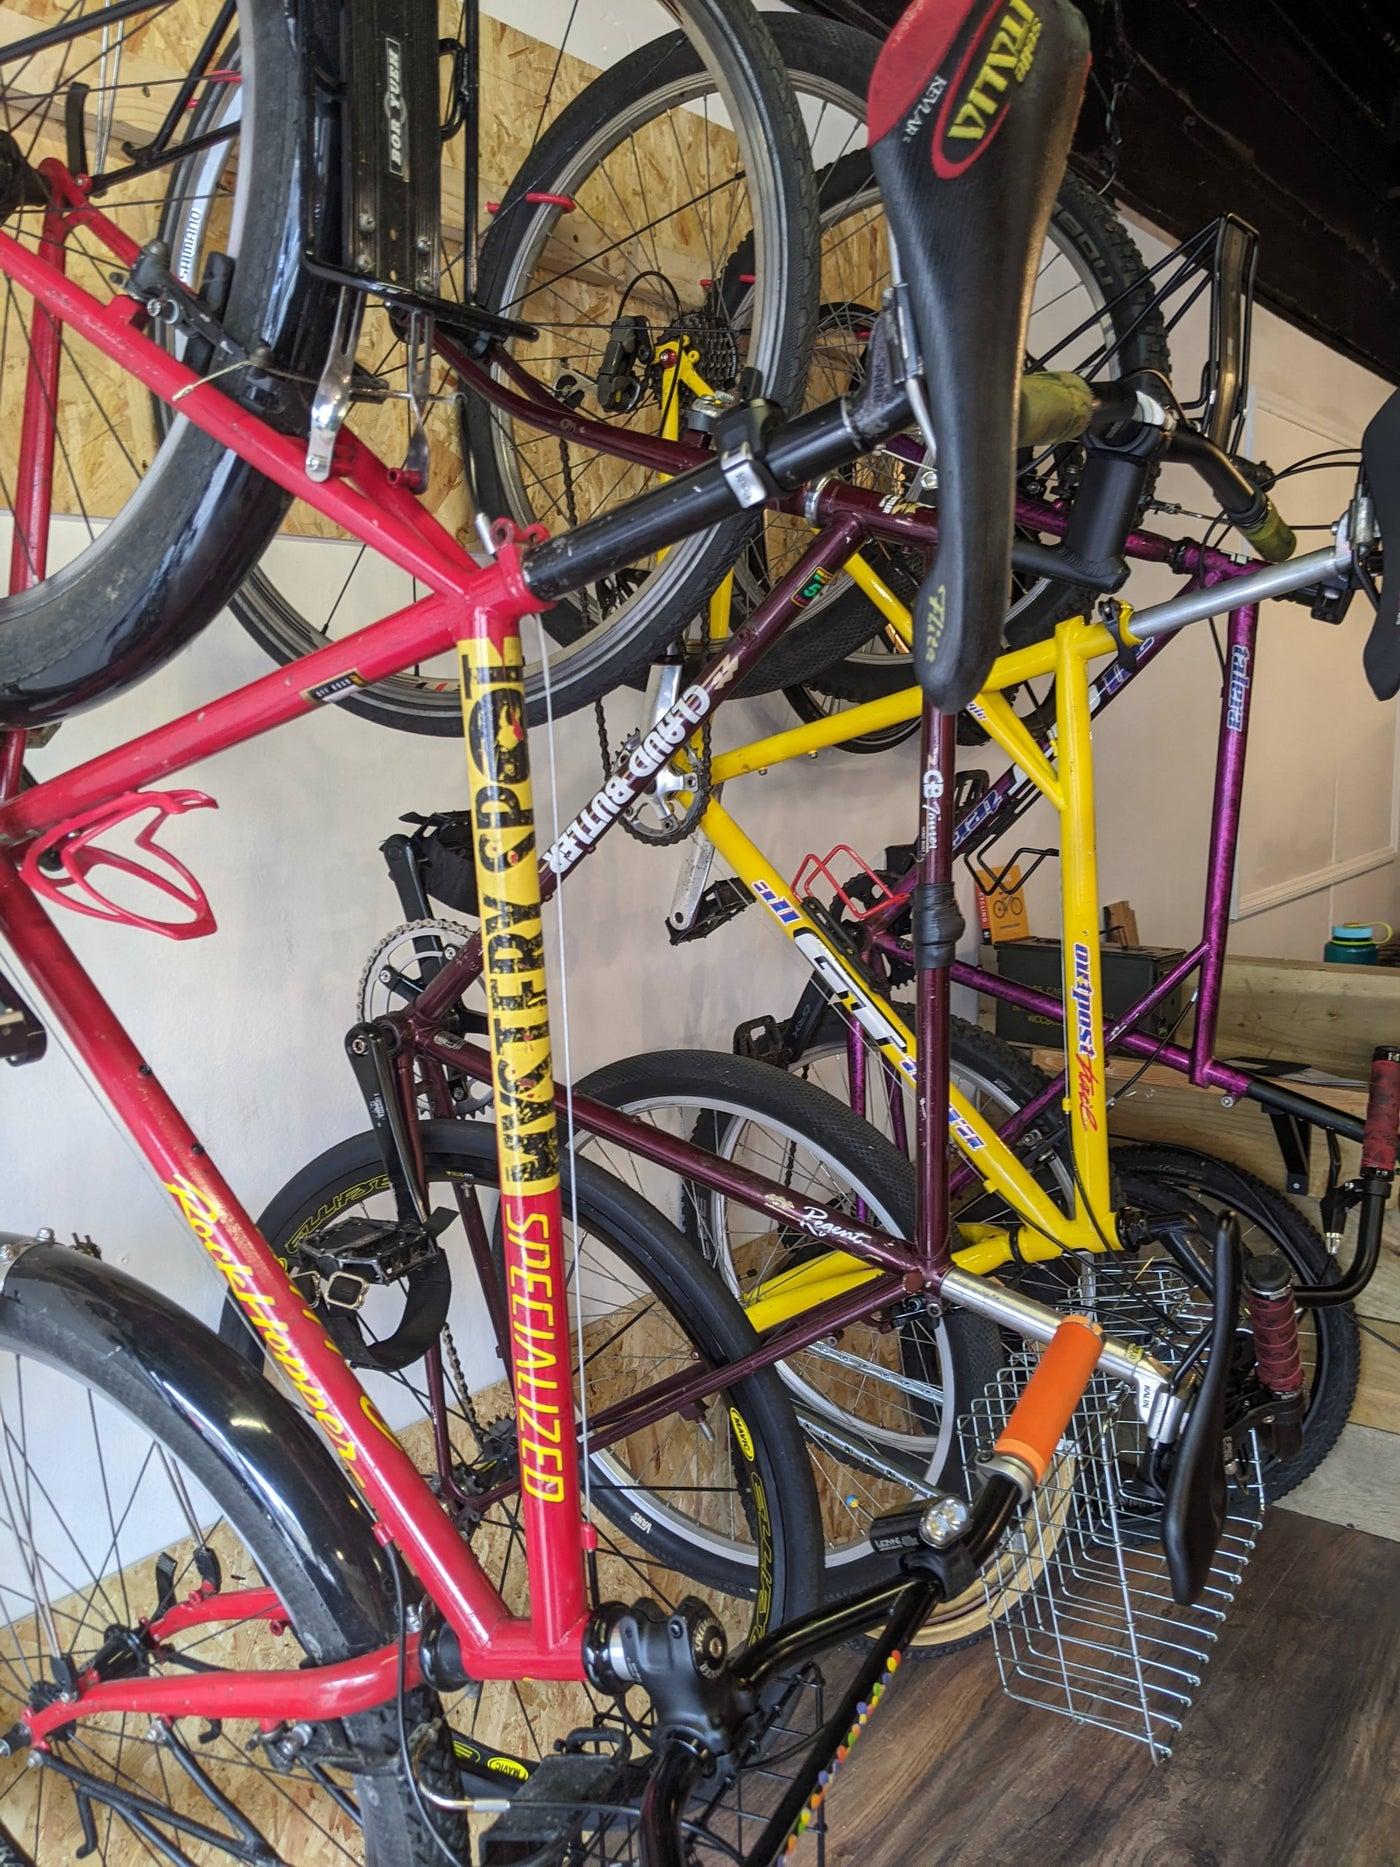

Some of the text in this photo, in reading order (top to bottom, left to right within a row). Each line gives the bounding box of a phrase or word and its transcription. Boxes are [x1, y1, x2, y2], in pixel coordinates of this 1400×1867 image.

[391, 119, 402, 167] BOR
[905, 75, 948, 137] KEVLAR
[1226, 644, 1250, 733] talera
[543, 684, 711, 874] CLAUD BUTLER
[794, 927, 908, 1052] GT
[1072, 941, 1097, 1059] outpost
[800, 1206, 873, 1244] Regent
[505, 1203, 566, 1505] SPECIALIZED
[733, 1416, 750, 1451] MAVIC
[630, 1511, 652, 1535] VANS
